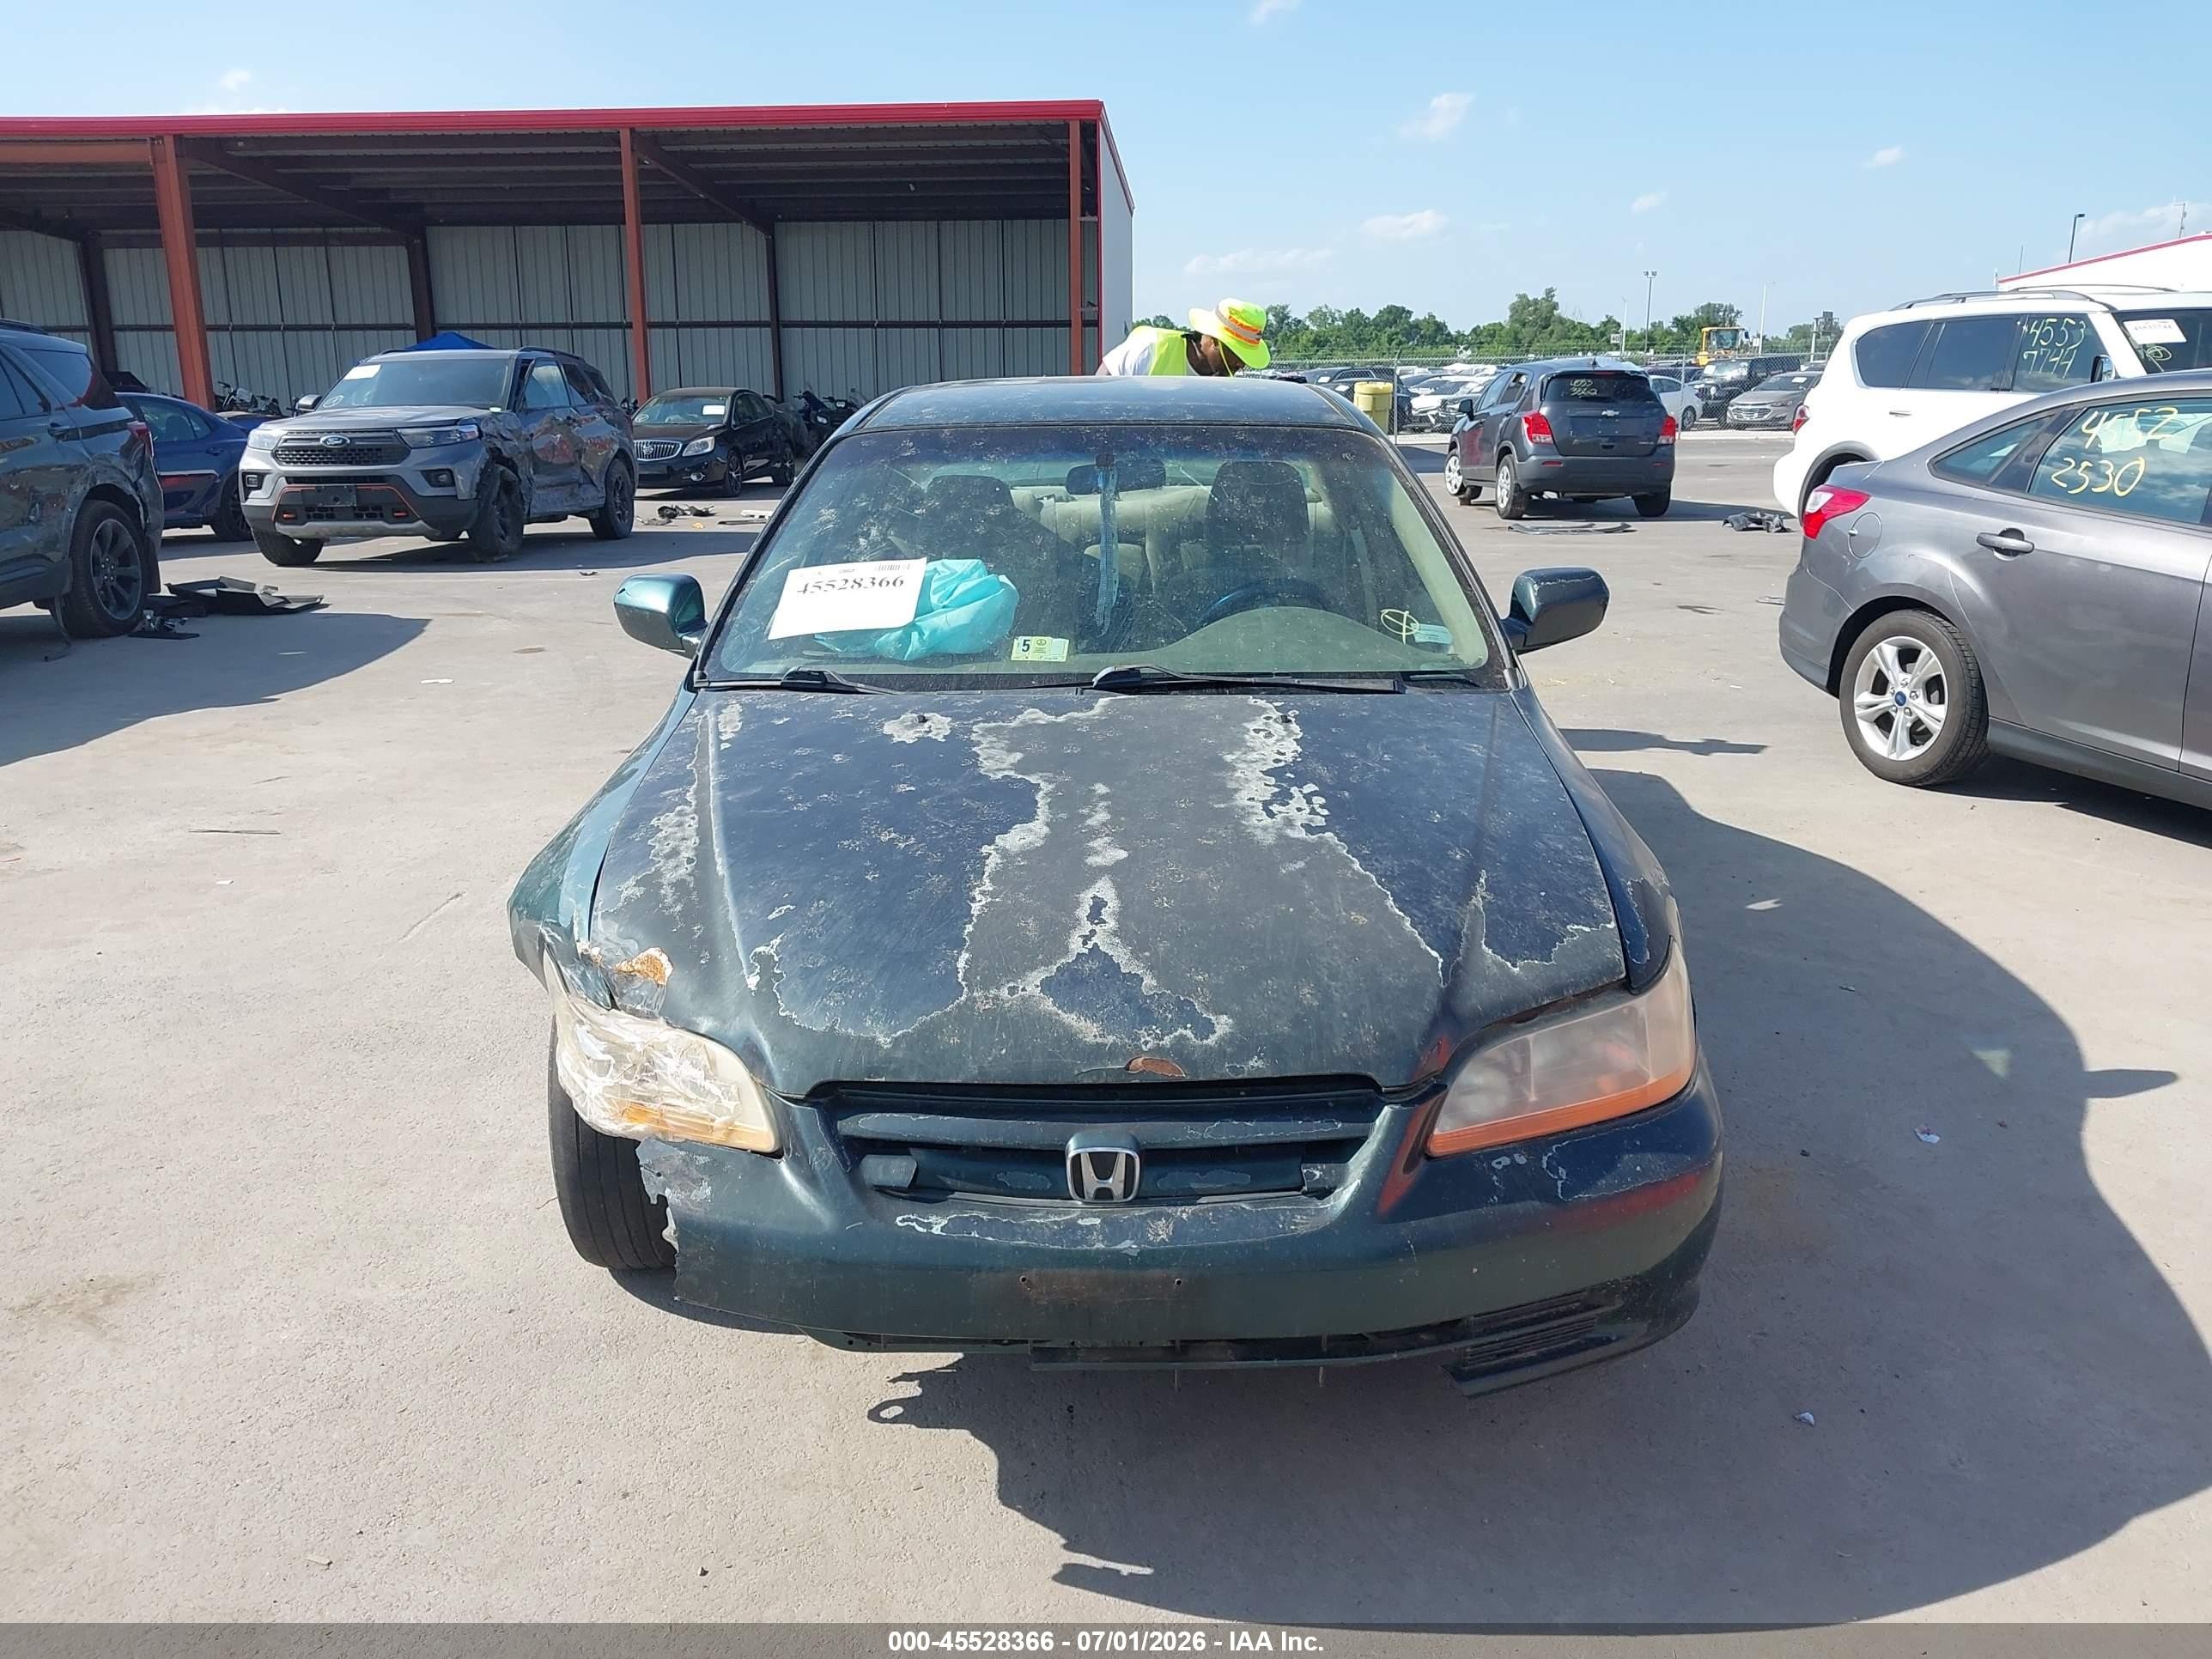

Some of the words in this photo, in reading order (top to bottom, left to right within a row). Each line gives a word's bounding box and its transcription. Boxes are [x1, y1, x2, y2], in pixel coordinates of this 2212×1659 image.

[2029, 318, 2087, 349] 4553
[2023, 348, 2078, 379] 7744
[2081, 407, 2179, 449] 4552
[2051, 456, 2146, 497] 2530
[797, 575, 904, 594] 45528366
[1022, 639, 1030, 652] 5
